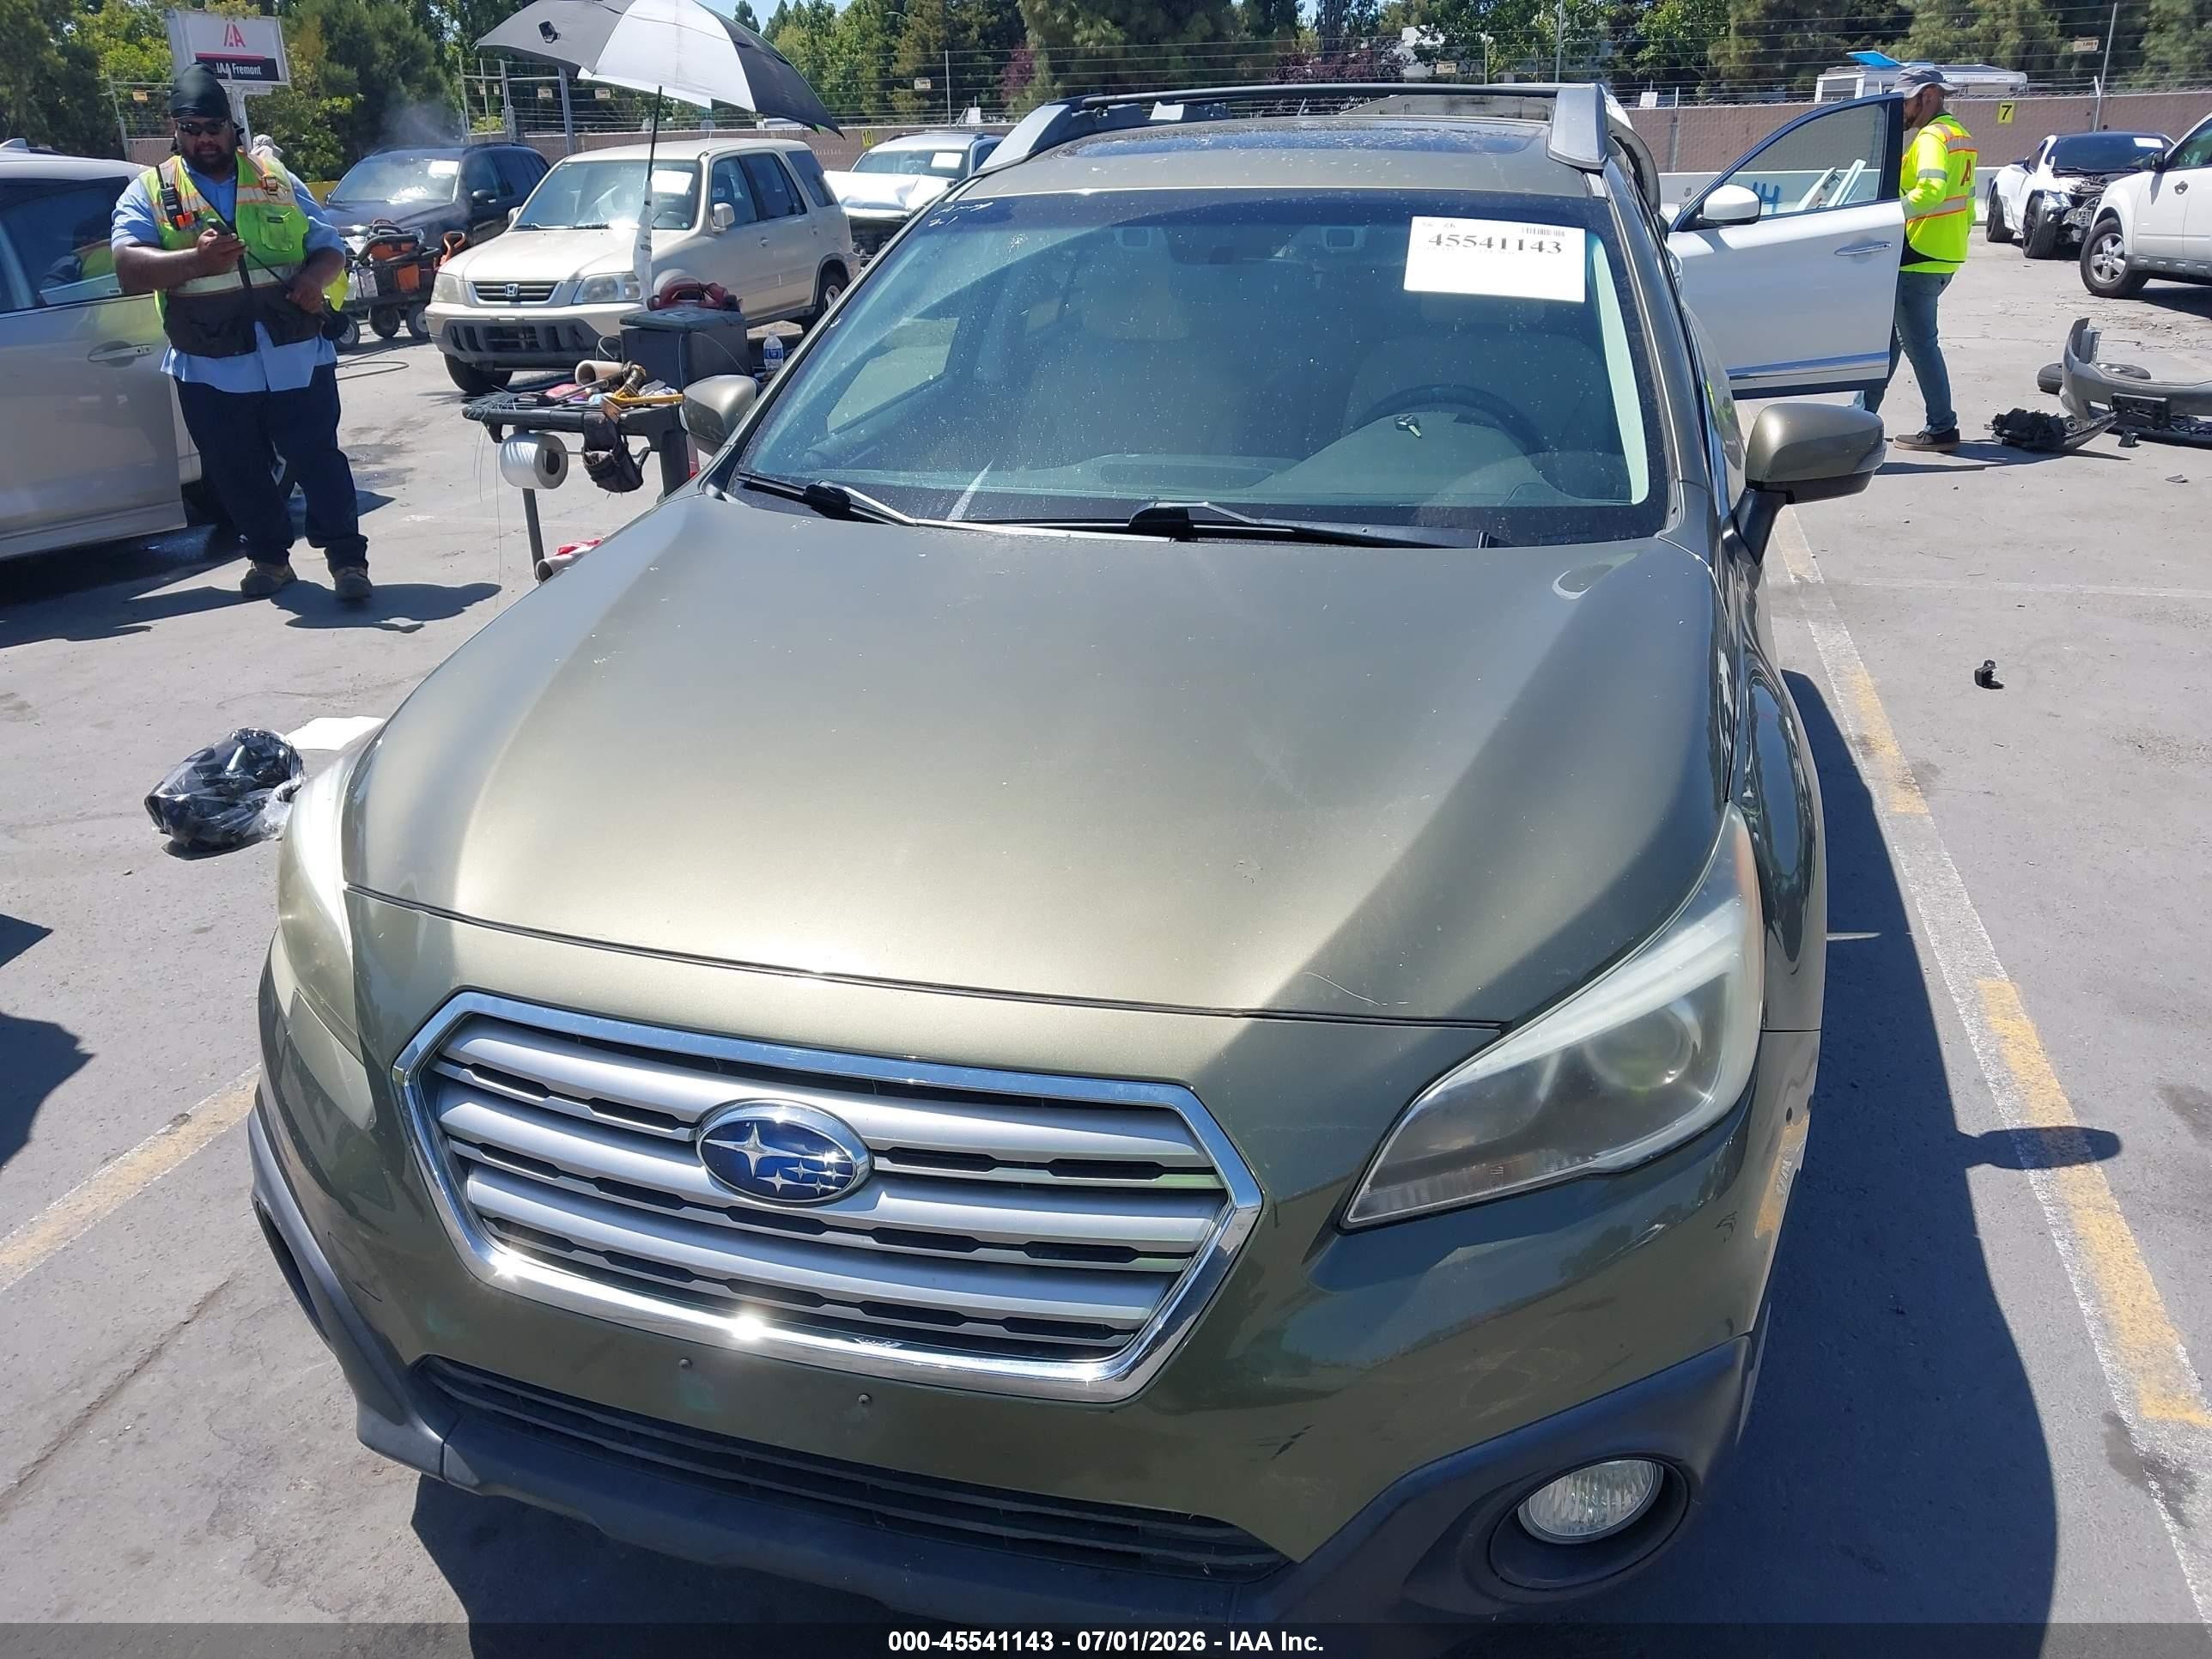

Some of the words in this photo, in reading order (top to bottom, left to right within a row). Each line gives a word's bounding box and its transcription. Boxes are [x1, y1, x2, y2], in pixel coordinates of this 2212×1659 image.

[232, 63, 262, 76] Fremont
[2002, 105, 2013, 120] 7
[862, 130, 872, 144] 10
[1428, 233, 1563, 254] 45541143
